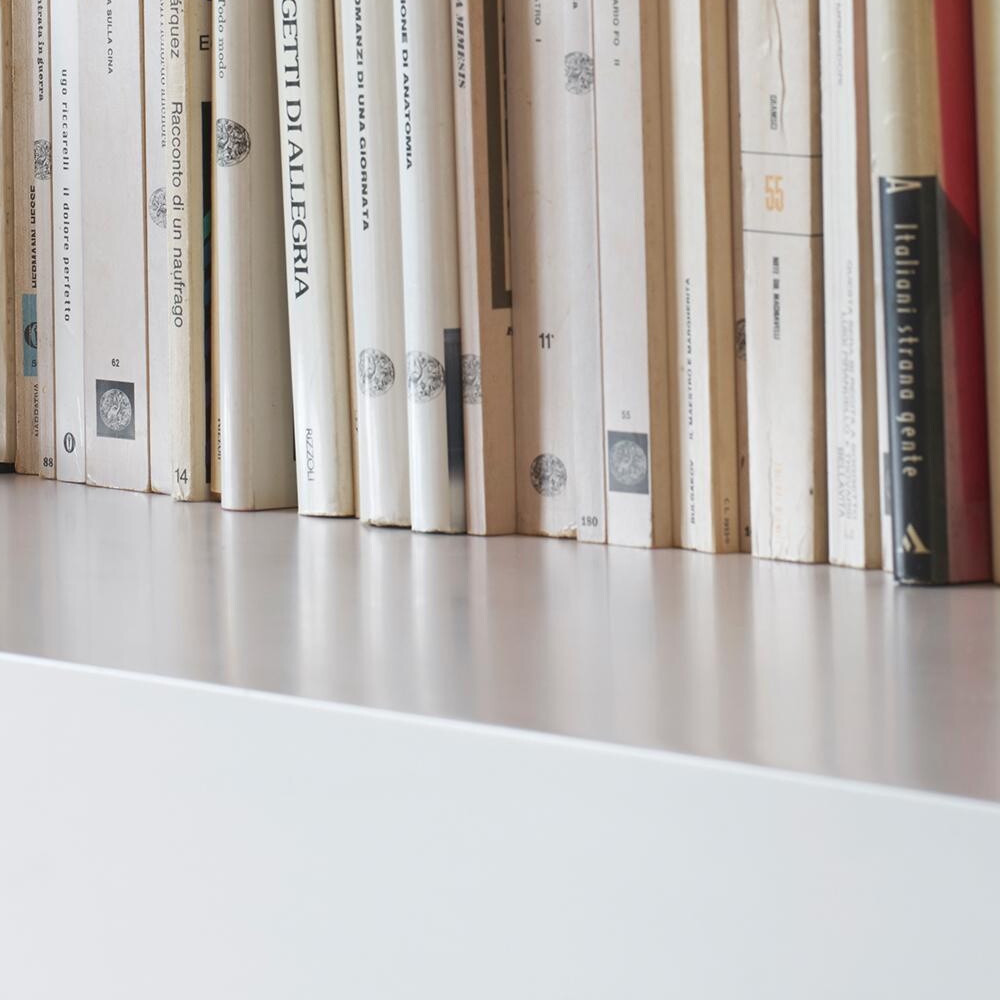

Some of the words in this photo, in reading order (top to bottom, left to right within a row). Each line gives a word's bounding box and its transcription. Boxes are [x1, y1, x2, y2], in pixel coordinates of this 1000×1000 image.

[38, 41, 45, 54] in
[217, 38, 228, 80] modo
[401, 48, 409, 68] DI
[455, 14, 466, 89] MIMESIS
[613, 30, 620, 47] FO
[36, 57, 45, 102] guerra
[60, 69, 69, 96] ugo
[357, 71, 364, 89] DI
[286, 100, 302, 132] DI
[358, 95, 366, 132] UNA
[402, 72, 412, 170] ANATOMIA
[61, 101, 70, 171] riccarelli
[171, 101, 184, 188] Racconto
[63, 187, 70, 198] il
[173, 195, 185, 211] di
[358, 138, 370, 232] GIORNATA
[63, 203, 71, 251] dolore
[173, 218, 184, 240] un
[288, 139, 310, 300] ALLEGRIA
[62, 257, 72, 322] perfetto
[171, 248, 186, 328] naufrago
[895, 223, 920, 315] Italiani
[112, 359, 120, 368] 62
[898, 324, 922, 400] strana
[43, 457, 54, 468] 88
[305, 428, 315, 482] RIZZOLI
[896, 411, 923, 478] gente
[174, 468, 189, 485] 14
